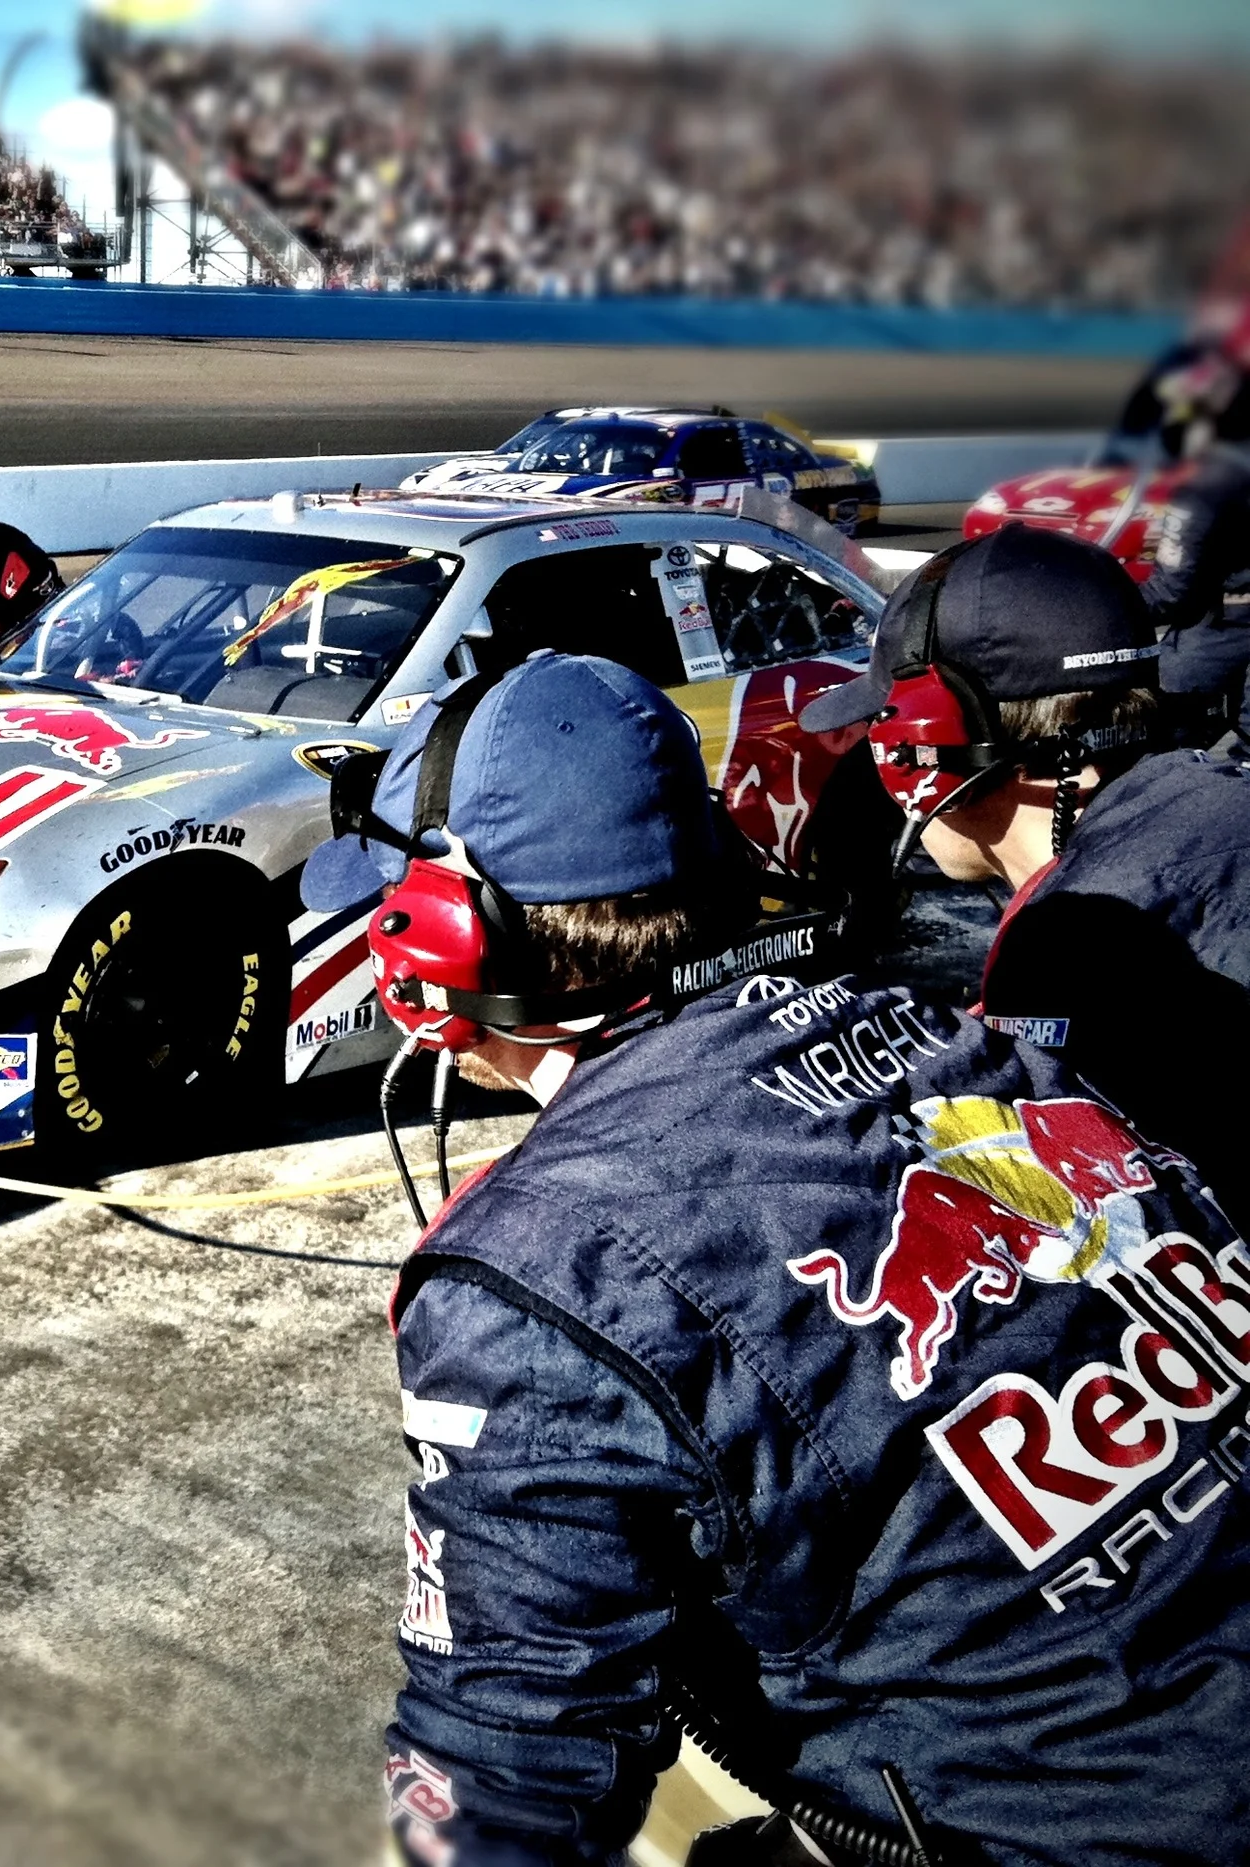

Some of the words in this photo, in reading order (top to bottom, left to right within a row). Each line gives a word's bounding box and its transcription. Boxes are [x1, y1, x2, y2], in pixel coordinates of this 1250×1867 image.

[1063, 651, 1115, 669] BEYOND
[1115, 648, 1138, 662] THE
[672, 955, 723, 995] RACING
[737, 926, 814, 976] ELECTRONICS
[225, 953, 259, 1061] EAGLE
[296, 1010, 349, 1046] Mobil
[769, 982, 859, 1034] TOYOTA
[999, 1019, 1057, 1045] NASCAR
[751, 1000, 951, 1117] WRIGHT
[924, 1263, 1242, 1571] Red
